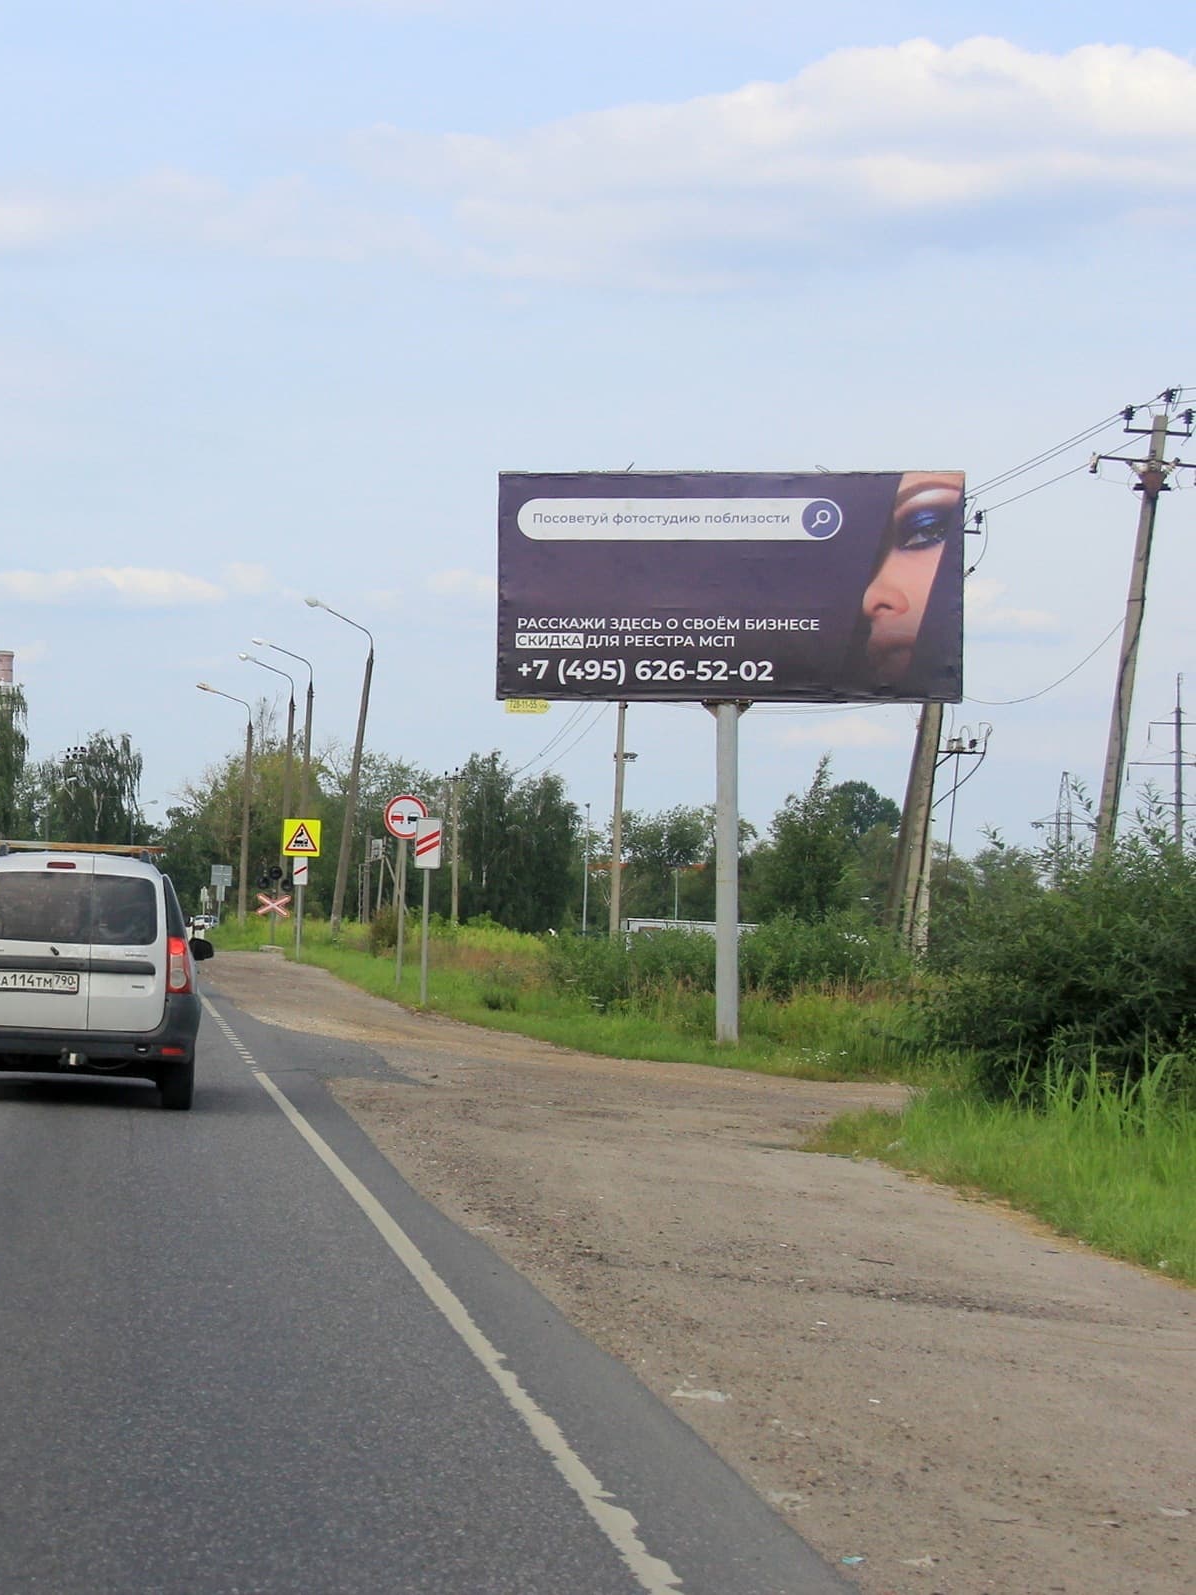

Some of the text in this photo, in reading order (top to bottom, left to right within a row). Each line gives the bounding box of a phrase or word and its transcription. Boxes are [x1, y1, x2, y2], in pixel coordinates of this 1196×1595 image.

[532, 511, 790, 526] Посоветуй фотостудию поблизости
[517, 615, 819, 631] РАССКАЖИ ЗДЕСЬ О СВОЁМ БИЗНЕСЕ
[516, 633, 735, 648] СКИДКА ДЛЯ РЕЕСТРА МСП
[517, 658, 774, 685] +7 (495) 626-52-02
[0, 973, 75, 988] А114ТМ 790
